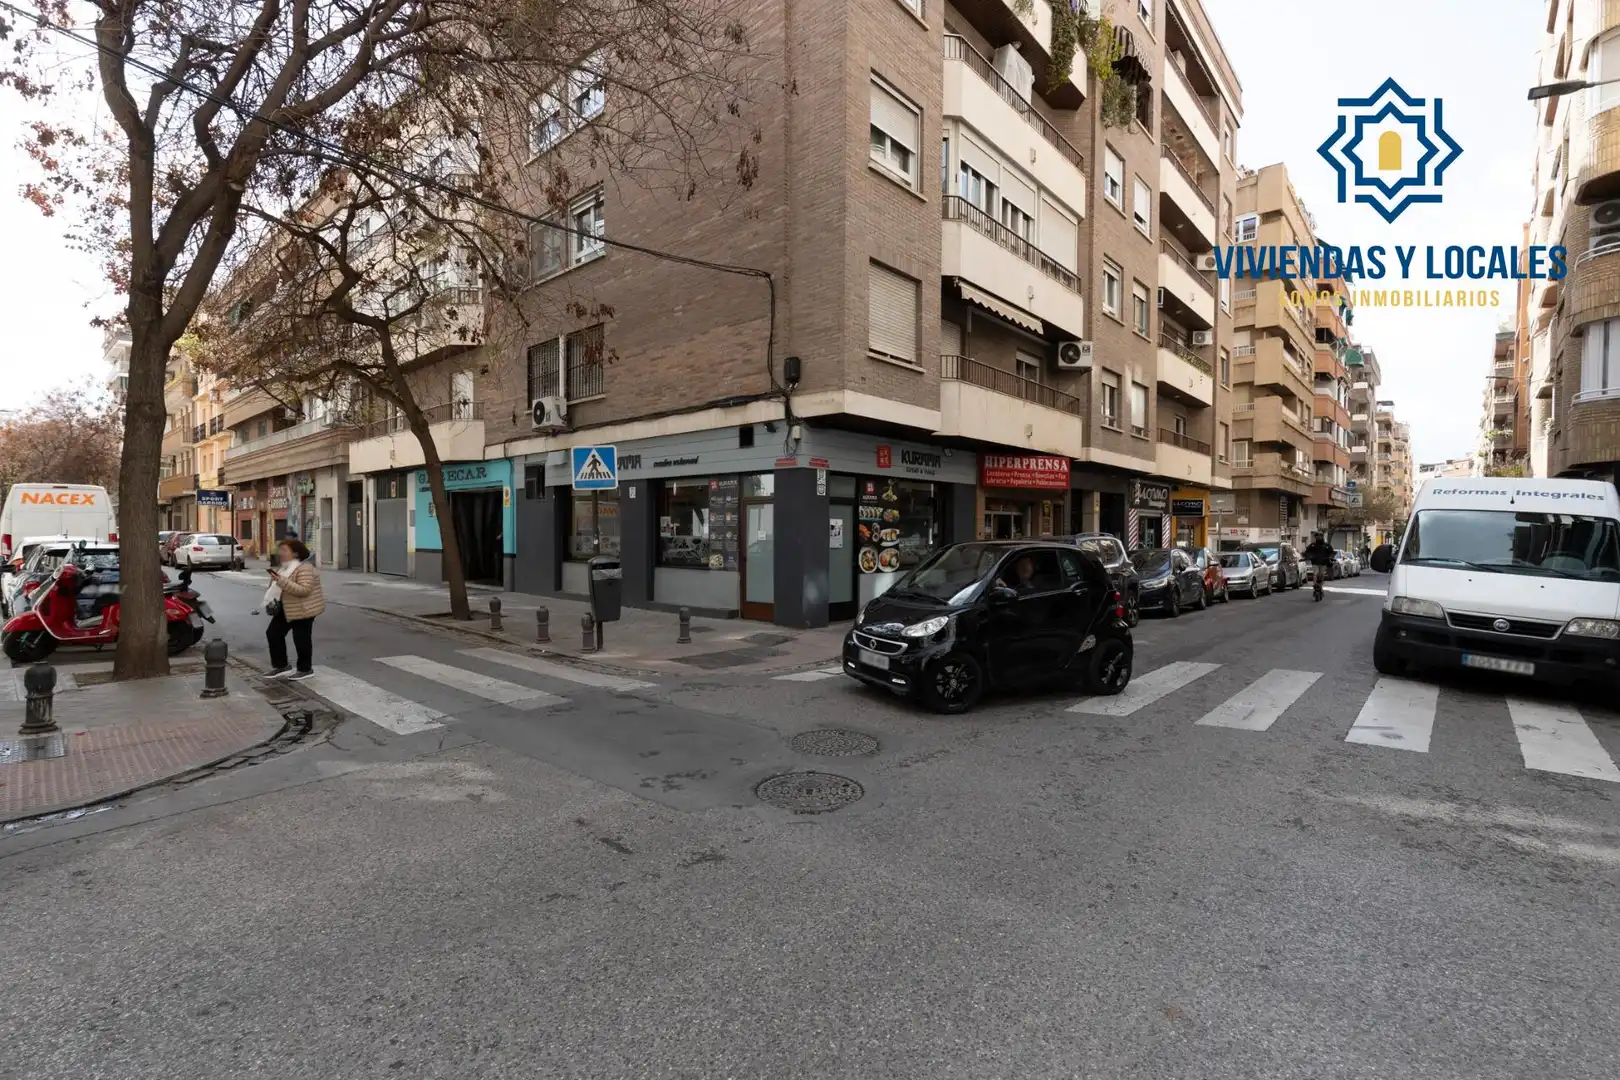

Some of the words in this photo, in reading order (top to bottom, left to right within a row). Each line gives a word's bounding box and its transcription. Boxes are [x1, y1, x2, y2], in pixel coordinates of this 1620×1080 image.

[985, 455, 1068, 472] HIPERPRENSA
[20, 492, 96, 506] NACEX
[1432, 488, 1507, 496] Reformas
[1515, 489, 1605, 501] Integrales
